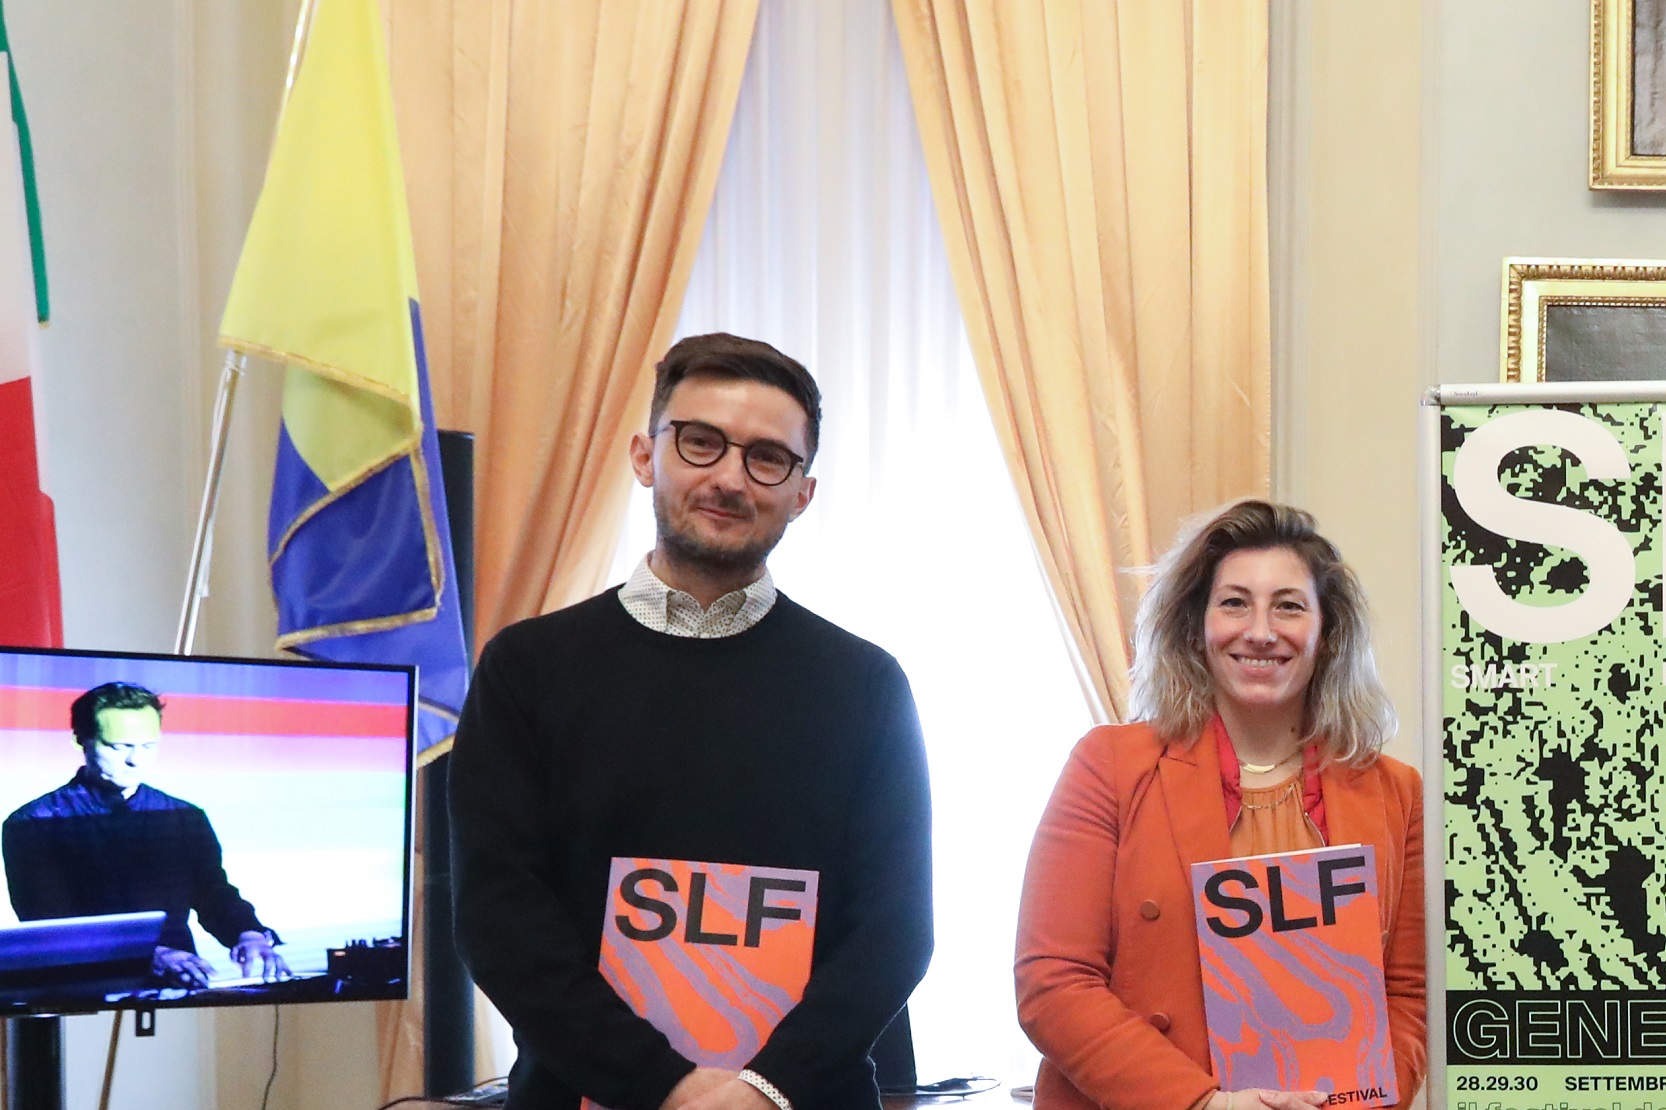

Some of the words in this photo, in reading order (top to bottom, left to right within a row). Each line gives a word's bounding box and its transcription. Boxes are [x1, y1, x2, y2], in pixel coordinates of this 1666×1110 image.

[1450, 662, 1557, 689] SMART
[615, 868, 806, 948] SLF
[1204, 855, 1366, 939] SLF
[1325, 1087, 1388, 1106] ESTIVAL
[1456, 1075, 1538, 1091] 28.29.30
